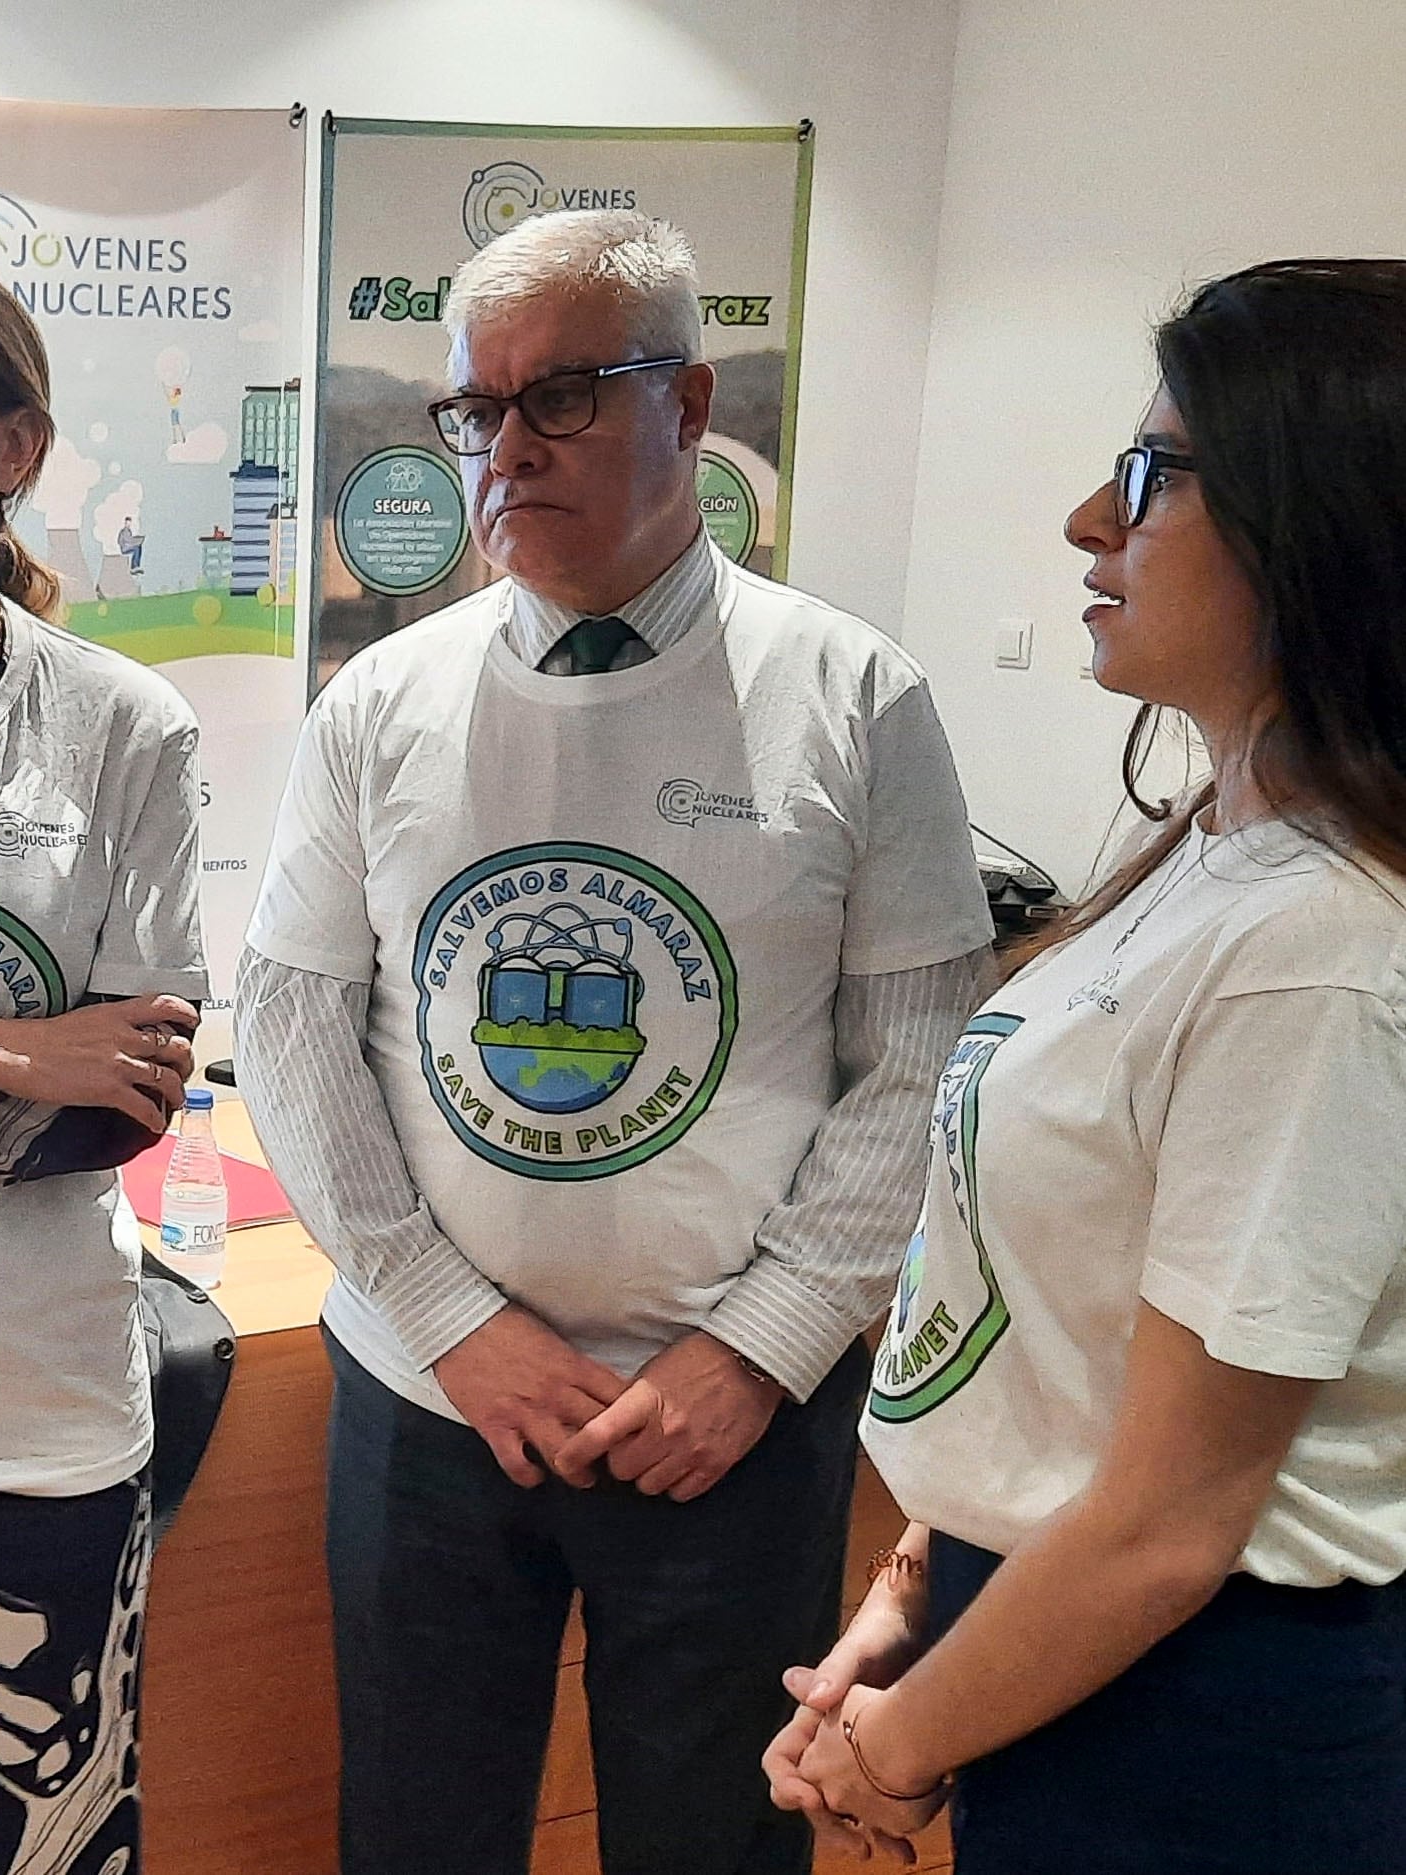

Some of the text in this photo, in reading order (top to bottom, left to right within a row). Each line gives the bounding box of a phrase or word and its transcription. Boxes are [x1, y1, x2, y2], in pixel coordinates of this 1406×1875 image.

[12, 281, 232, 320] NUCLEARES
[373, 499, 433, 515] SEGURA
[430, 868, 711, 1002] SALVEMOS ALMARAZ
[437, 1053, 692, 1155] SAVE THE PLANET
[891, 1299, 959, 1386] LANET
